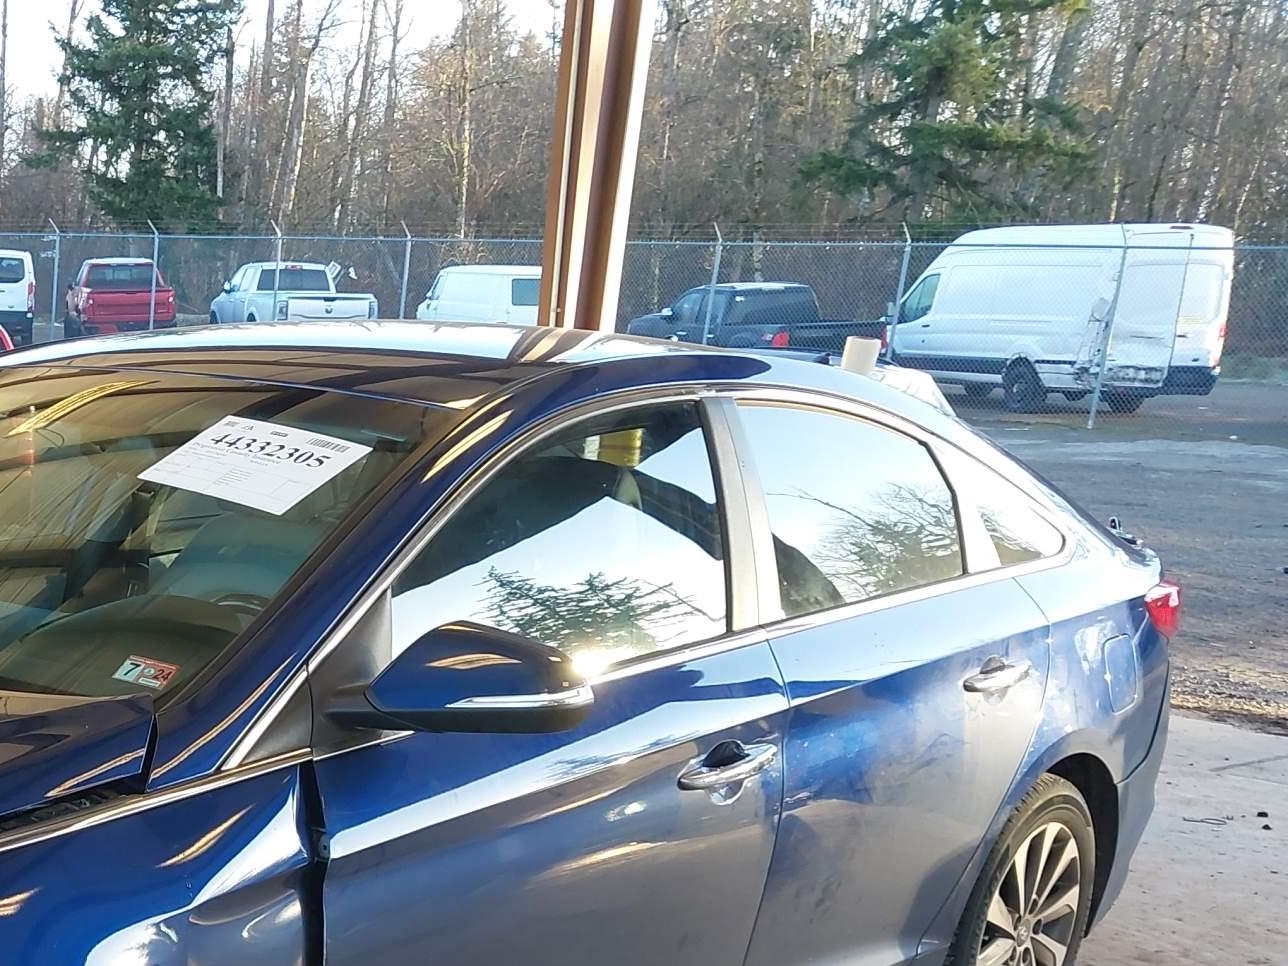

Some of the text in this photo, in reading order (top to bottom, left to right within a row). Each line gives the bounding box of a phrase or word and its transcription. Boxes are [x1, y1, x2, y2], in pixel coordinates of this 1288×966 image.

[209, 432, 332, 468] 44332305
[122, 662, 173, 681] 7 24
